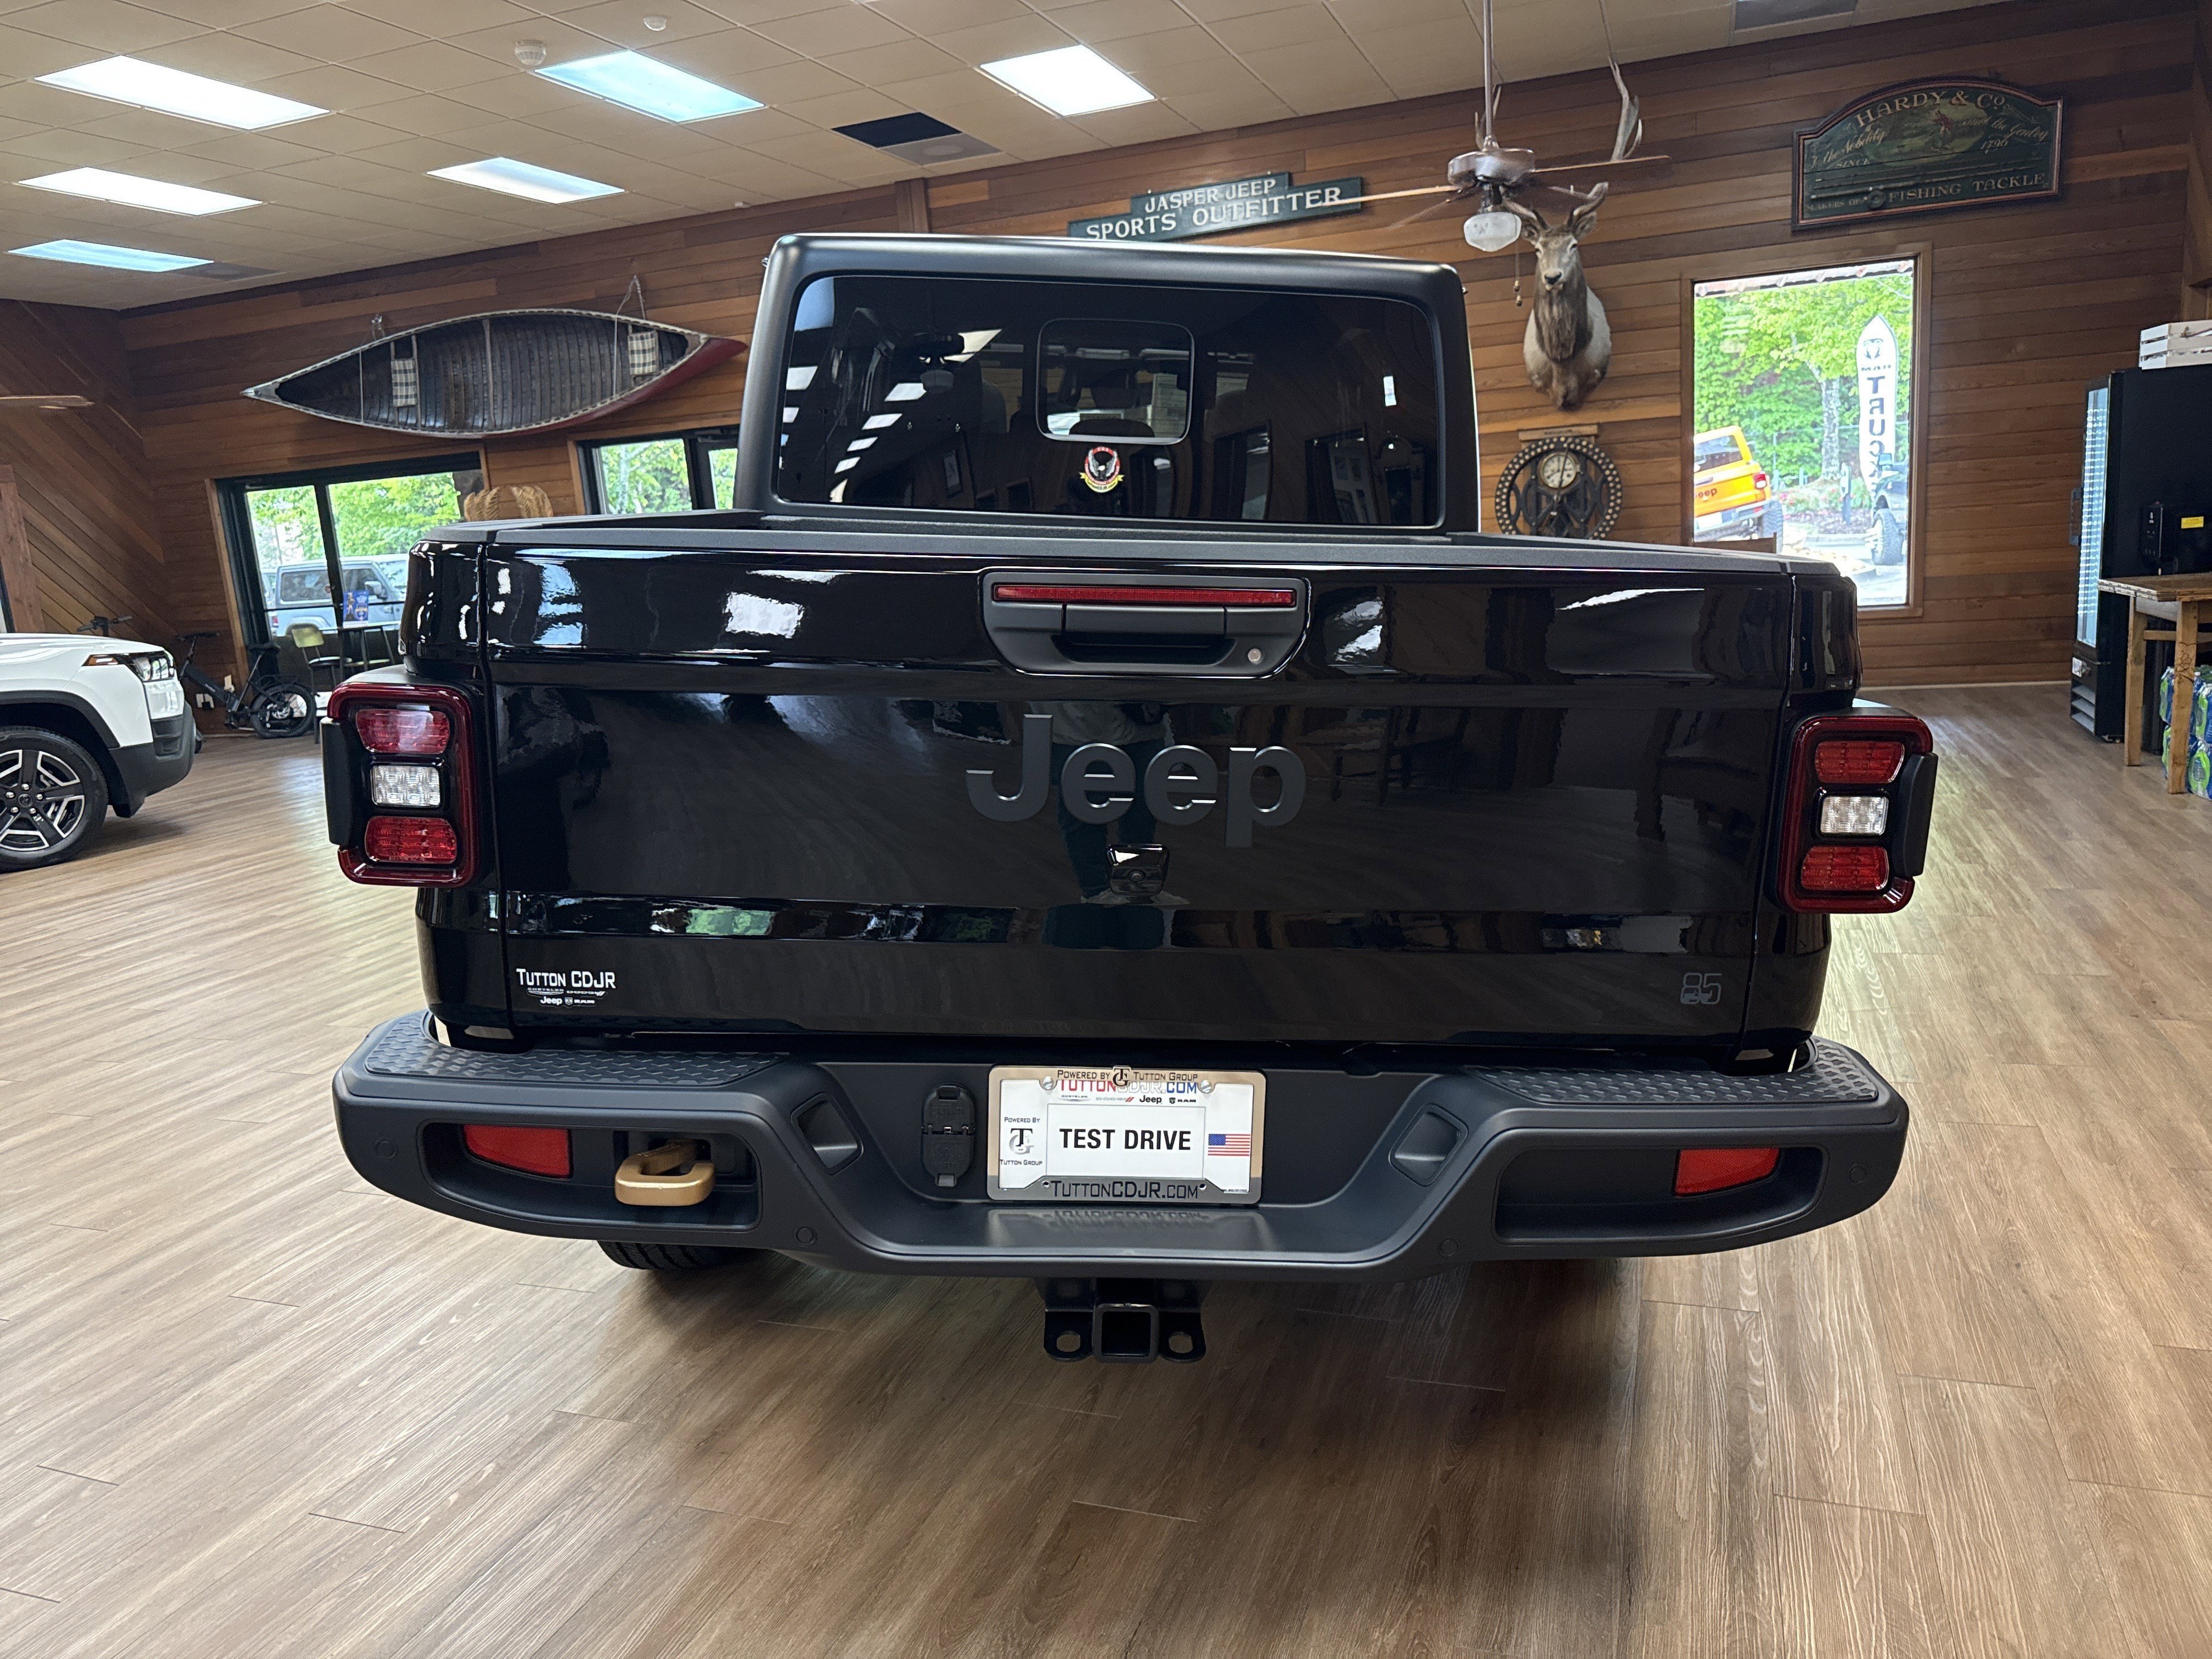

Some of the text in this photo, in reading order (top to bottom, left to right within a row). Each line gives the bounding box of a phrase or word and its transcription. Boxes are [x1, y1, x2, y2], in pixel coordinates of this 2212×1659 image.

[1855, 90, 1948, 128] HARDY
[1949, 90, 1971, 107] &
[1144, 178, 1276, 213] JASPER JEEP
[1888, 173, 2045, 202] FISHING TACKLE
[1086, 187, 1342, 240] SPORTS OUTFITTER
[966, 713, 1307, 848] Jeep
[516, 968, 616, 989] TUTTON CDJR
[540, 996, 563, 1006] Jeep
[1057, 1069, 1097, 1079] POWERED
[1133, 1071, 1166, 1080] TUTTON
[1169, 1072, 1198, 1081] GROUP
[1139, 1094, 1163, 1104] Jeep
[1059, 1128, 1191, 1150] TEST DRIVE
